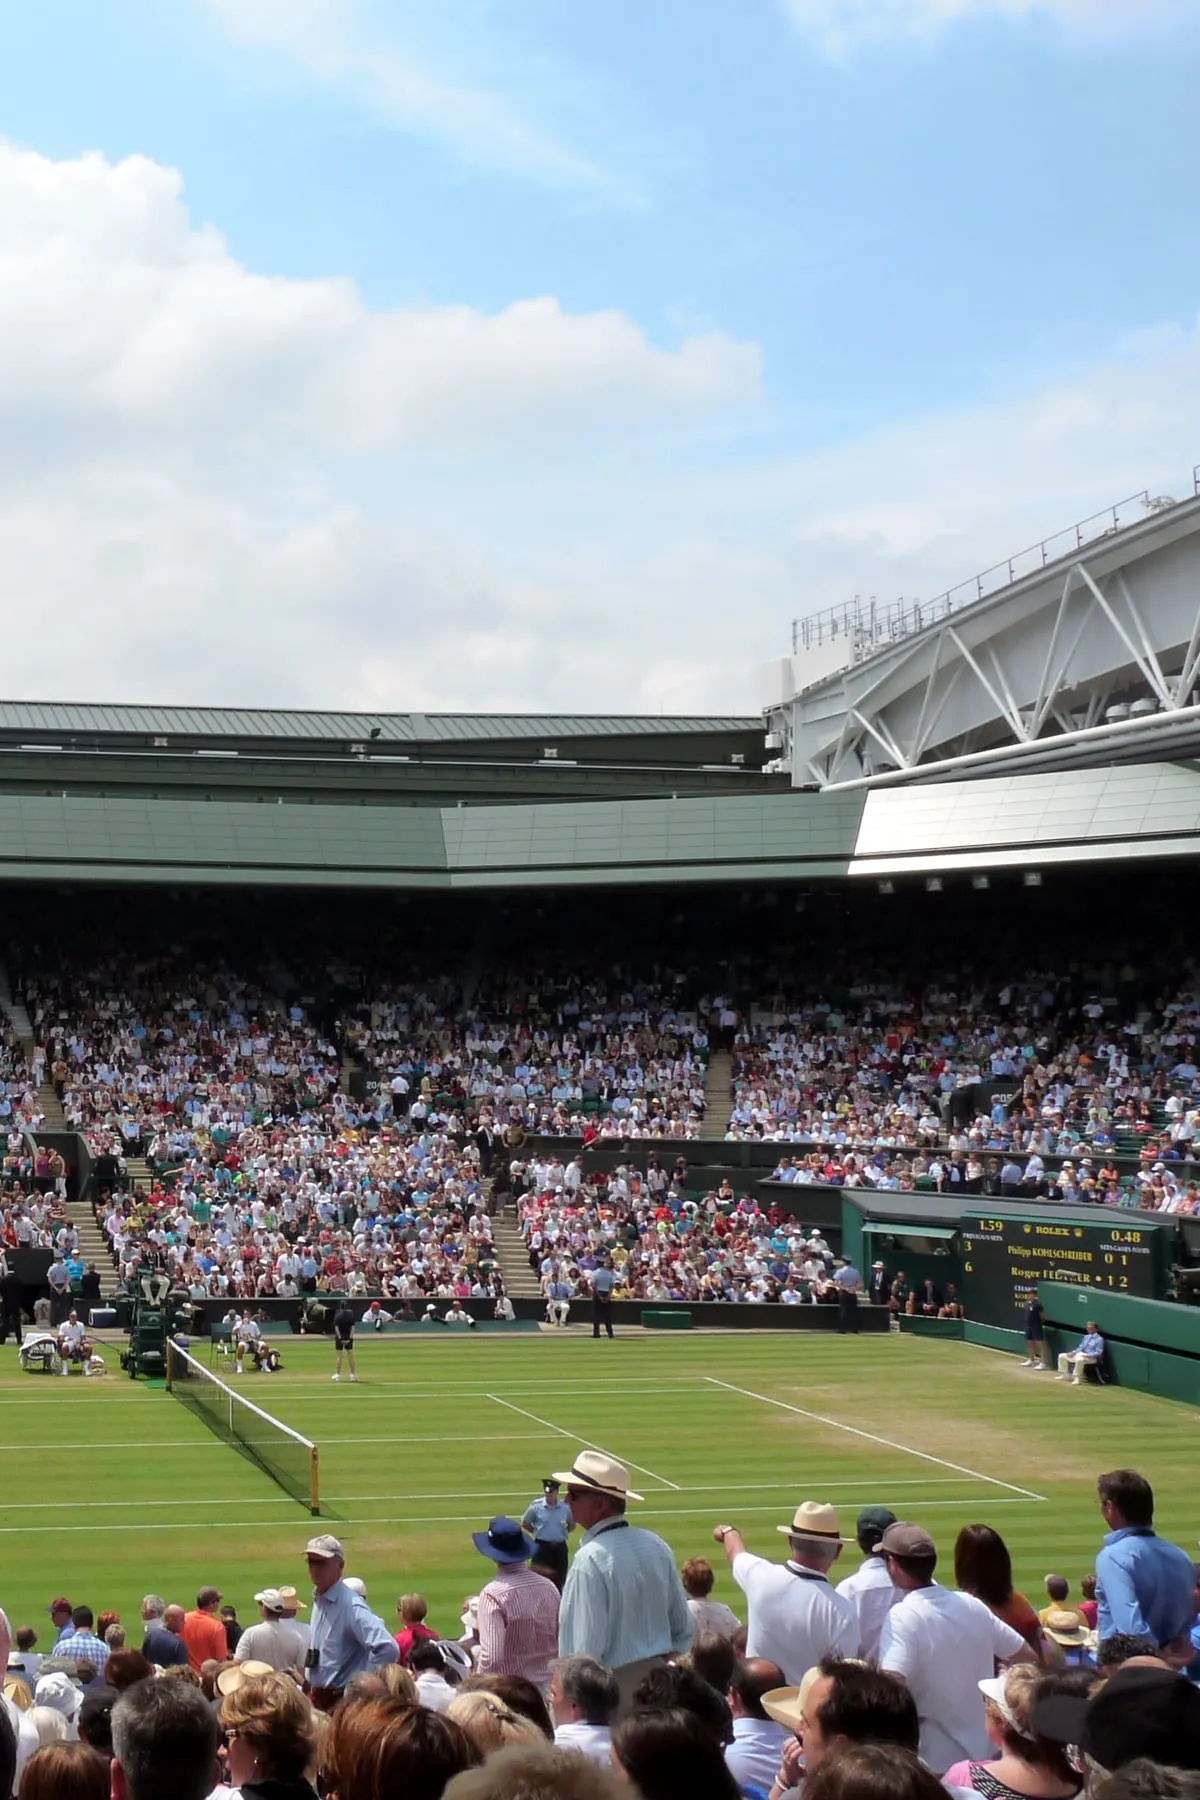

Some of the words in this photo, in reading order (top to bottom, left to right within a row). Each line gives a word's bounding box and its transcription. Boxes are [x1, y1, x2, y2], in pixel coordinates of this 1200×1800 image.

[979, 1219, 1004, 1232] 1.59
[1036, 1225, 1070, 1237] ROLEX
[1111, 1230, 1141, 1243] 0.48
[963, 1240, 972, 1251] 3
[1007, 1245, 1031, 1258] Philipp
[1032, 1247, 1093, 1262] KOHLSCHREIBER
[1104, 1252, 1113, 1264] 0
[1120, 1254, 1128, 1266] 1
[964, 1261, 973, 1272] 6
[1011, 1266, 1041, 1279] Roger
[1107, 1274, 1114, 1287] 1
[1119, 1275, 1128, 1288] 2
